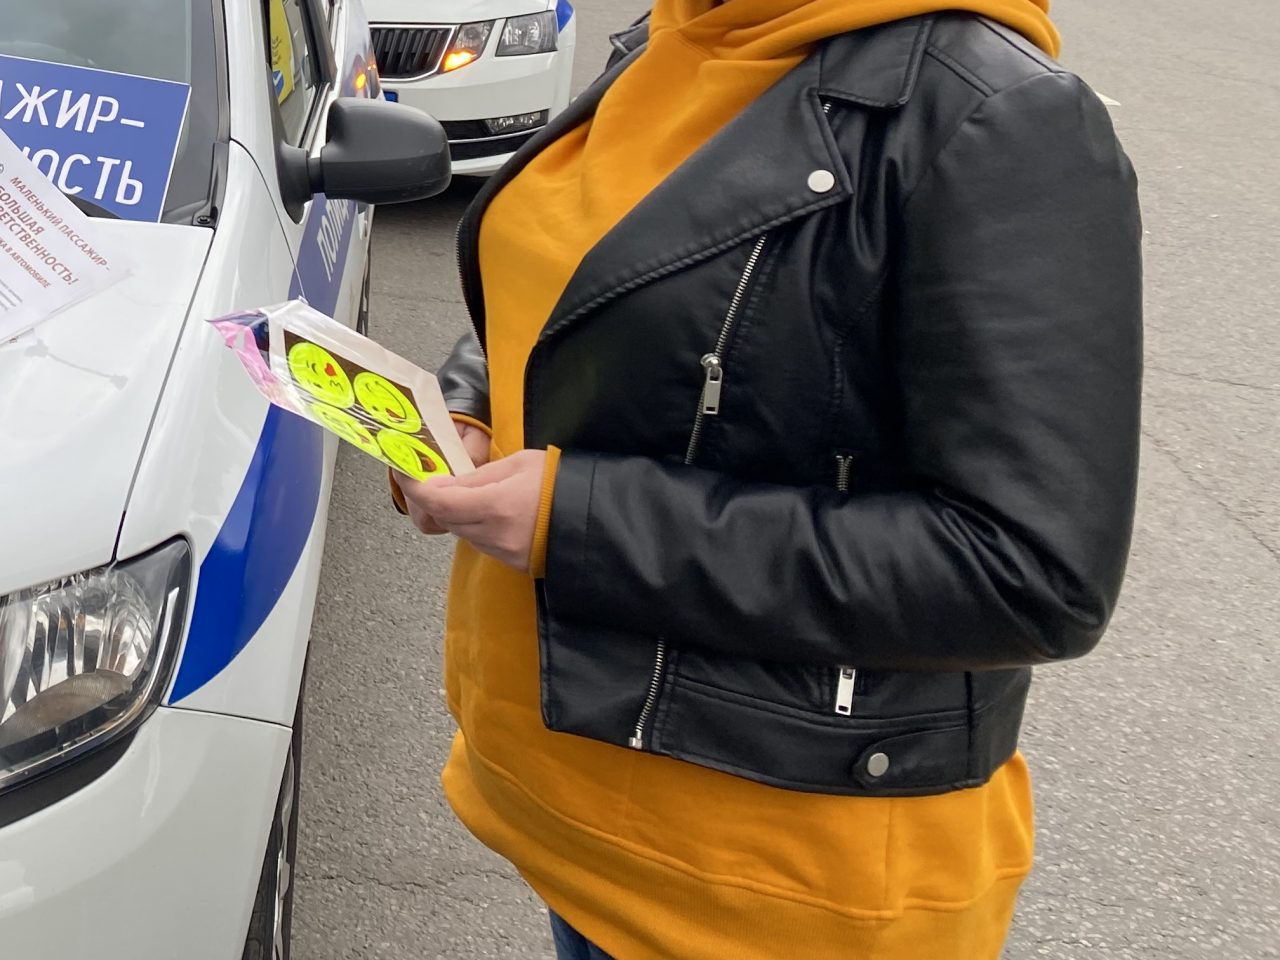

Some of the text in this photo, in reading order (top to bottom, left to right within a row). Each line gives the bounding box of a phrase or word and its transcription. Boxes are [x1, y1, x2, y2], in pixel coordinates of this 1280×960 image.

[10, 176, 63, 226] МАЛЕНЬКИЙ
[58, 224, 108, 267] ПАССАЖИР
[9, 252, 52, 289] АВТОМОБИЛЕ
